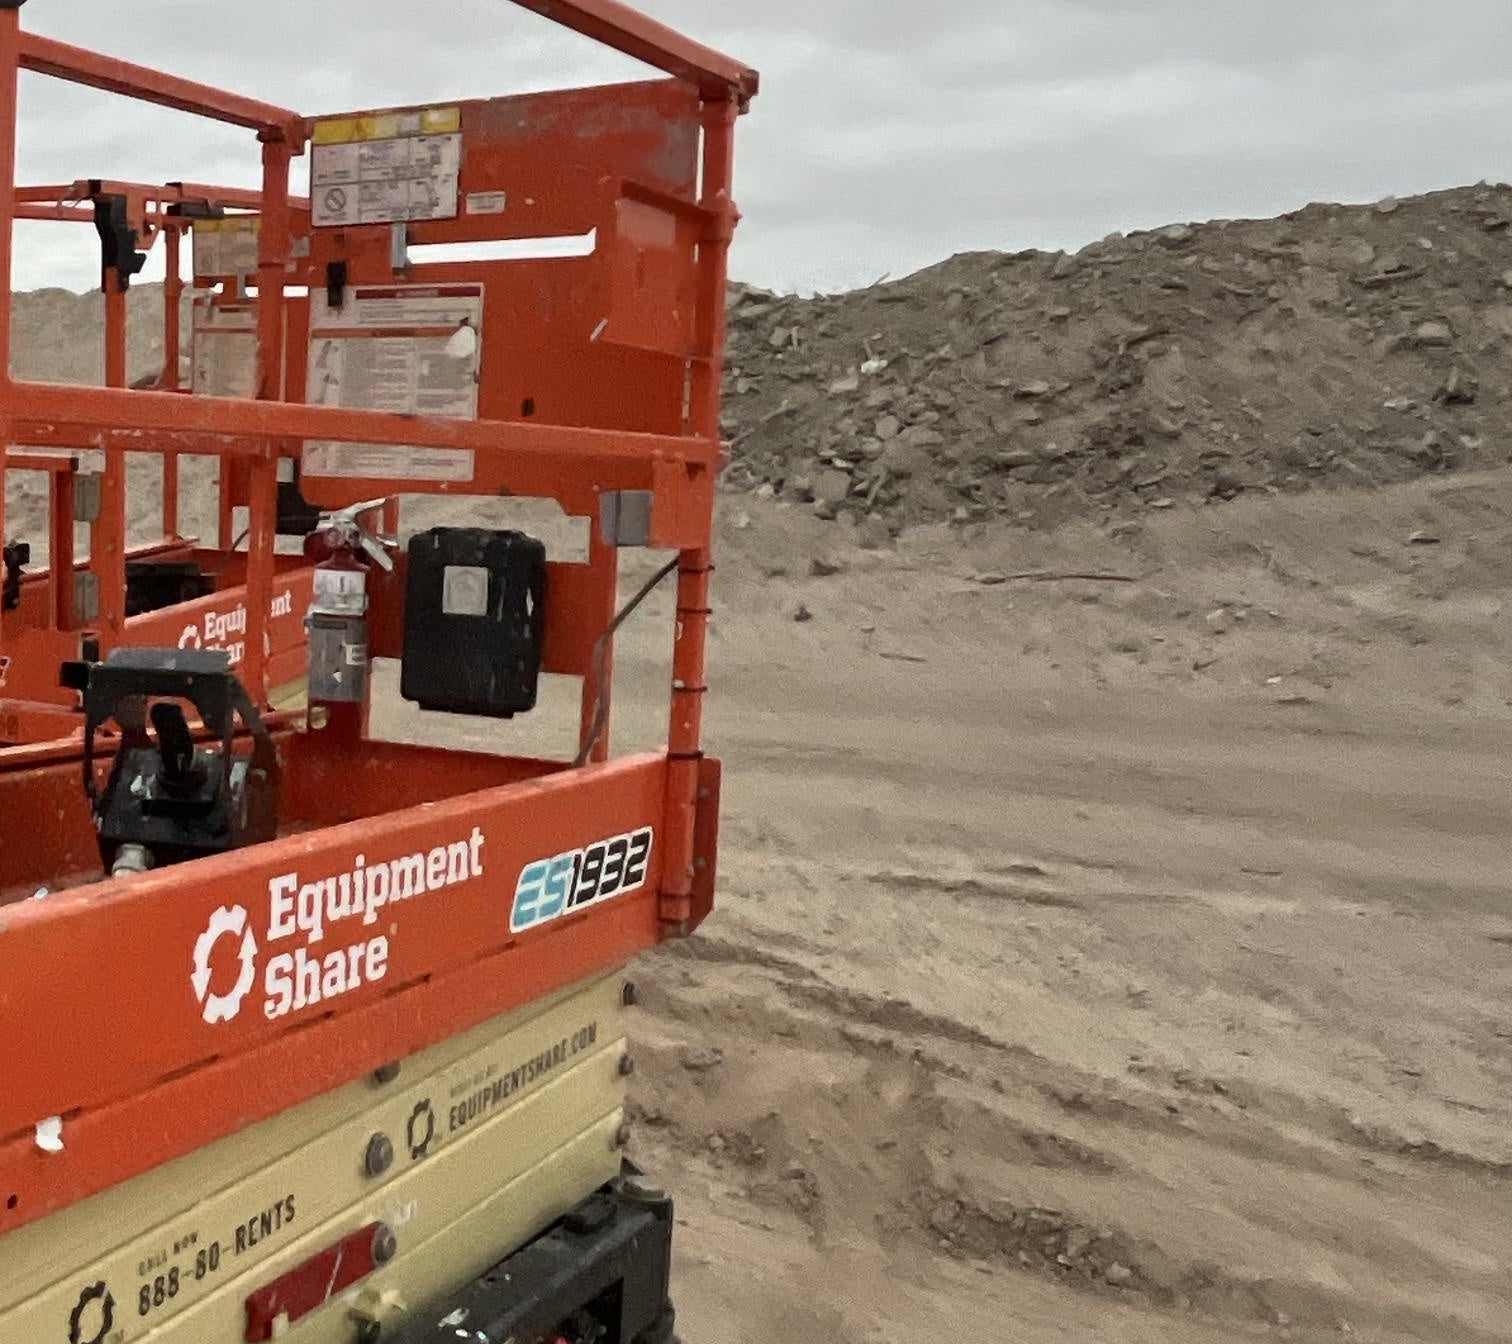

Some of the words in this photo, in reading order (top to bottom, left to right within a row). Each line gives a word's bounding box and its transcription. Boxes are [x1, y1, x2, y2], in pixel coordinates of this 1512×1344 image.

[204, 589, 292, 641] Equint
[266, 826, 485, 943] Equipment
[509, 826, 654, 934] ES1932
[263, 935, 390, 1020] Share
[449, 1021, 597, 1132] EQUIPMENTSHARE.COM
